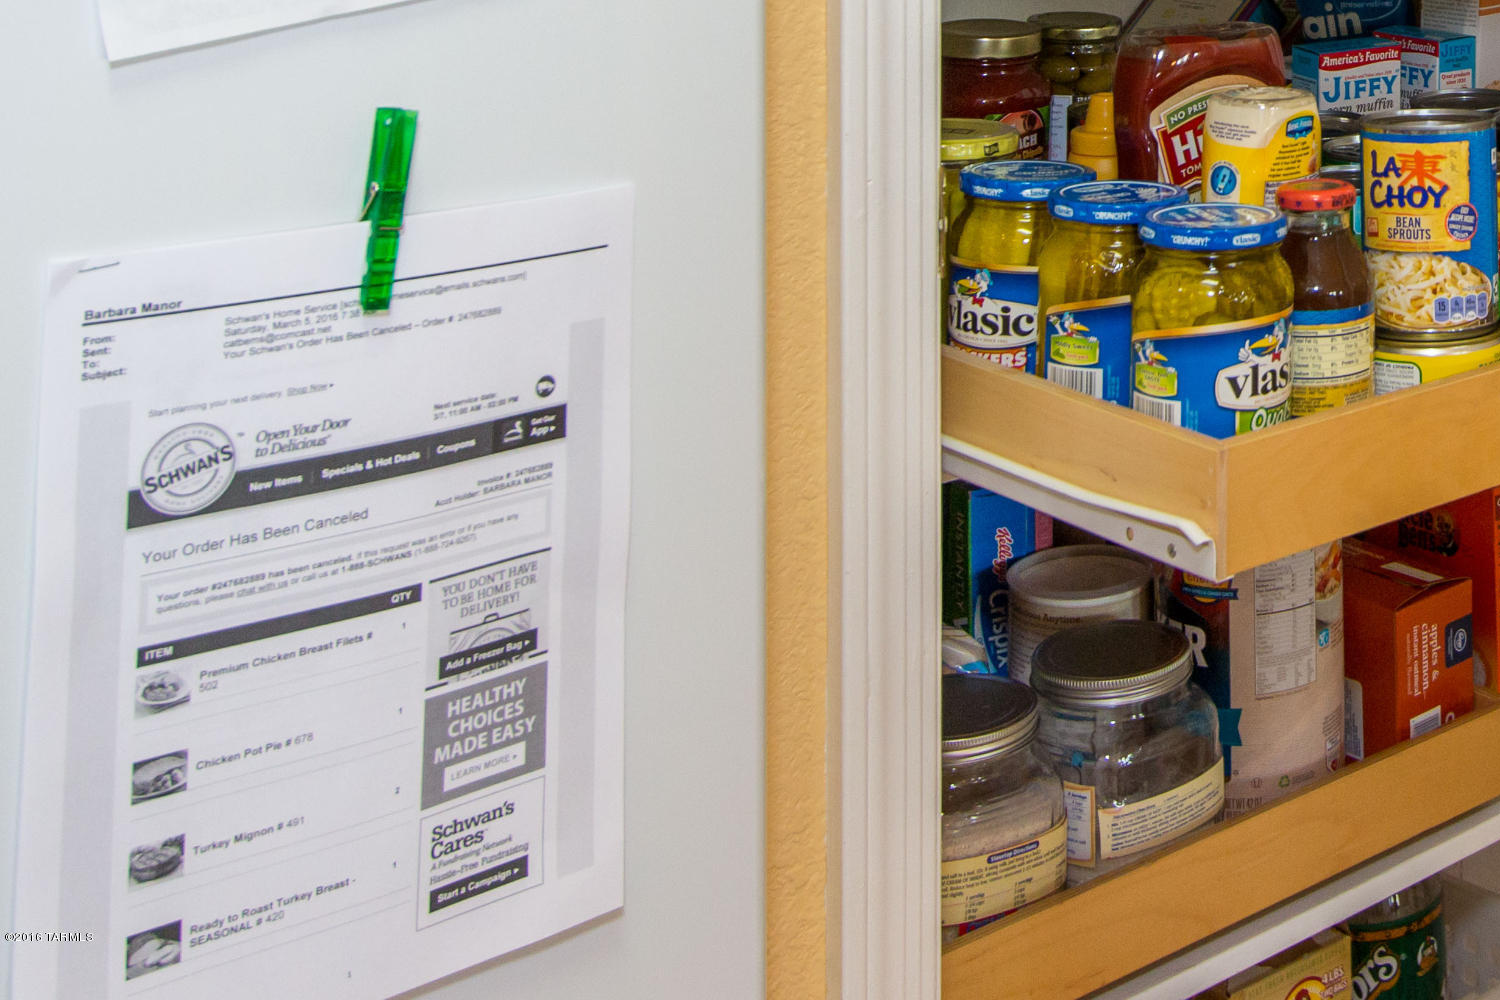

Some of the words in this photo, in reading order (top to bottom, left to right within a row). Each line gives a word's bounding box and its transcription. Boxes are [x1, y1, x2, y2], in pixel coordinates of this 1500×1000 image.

[1303, 2, 1363, 40] ain
[1321, 52, 1365, 68] America's
[1365, 50, 1400, 63] Favorite
[1407, 41, 1437, 55] Favorite
[1441, 43, 1473, 58] JIFFY
[1322, 75, 1398, 103] JIFFY
[1400, 65, 1434, 89] FFY
[1169, 111, 1184, 124] NO
[1356, 98, 1394, 113] muffin
[1181, 162, 1203, 178] TOM
[1371, 149, 1402, 178] LA
[1370, 179, 1450, 209] CHOY
[1387, 228, 1432, 240] SPROUTS
[1395, 216, 1421, 228] BEAN
[83, 306, 137, 321] Barbara
[141, 300, 182, 313] Manor
[82, 346, 112, 357] Sent:
[83, 335, 116, 346] From:
[81, 367, 127, 382] Subject:
[82, 360, 100, 369] To:
[1225, 362, 1291, 400] vlas
[255, 429, 290, 444] Open
[291, 423, 319, 438] Your
[322, 417, 352, 432] Door
[255, 447, 267, 458] to
[270, 438, 323, 455] Delicious
[437, 439, 476, 454] Coupons
[144, 444, 234, 494] SCHWAN'S
[322, 463, 364, 479] Specials
[376, 455, 393, 467] Hot
[395, 451, 421, 463] Deals
[249, 481, 273, 492] New
[142, 547, 177, 564] Your
[182, 538, 224, 556] Order
[230, 531, 258, 546] Has
[263, 522, 300, 540] Been
[304, 509, 369, 531] Canceled
[442, 583, 465, 597] YOU
[469, 569, 506, 590] DON'T
[508, 560, 538, 578] HAVE
[442, 597, 458, 610] TO
[460, 592, 474, 605] BE
[477, 581, 511, 600] HOME
[514, 574, 536, 589] FOR
[391, 590, 412, 603] QTY
[460, 592, 520, 618] DELIVERY!
[144, 646, 174, 661] ITEM
[199, 661, 249, 680] Premium
[252, 650, 296, 667] Chicken
[299, 641, 332, 657] Breast
[336, 634, 364, 648] Filets
[446, 658, 465, 670] Add
[472, 647, 504, 662] Freezer
[505, 640, 522, 652] Bag
[1421, 623, 1430, 690] cinnamon
[1429, 624, 1442, 666] apples
[1413, 660, 1422, 697] oatmeal
[1432, 670, 1440, 681] &
[448, 678, 527, 718] HEALTHY
[448, 699, 524, 738] CHOICES
[434, 732, 488, 764] MADE
[492, 715, 536, 745] EASY
[195, 752, 241, 770] Chicken
[244, 746, 262, 758] Pot
[265, 742, 282, 753] Pie
[450, 764, 482, 781] LEARN
[483, 754, 510, 769] MORE
[432, 800, 515, 842] Schwan's
[192, 839, 230, 855] Turkey
[234, 825, 274, 843] Mignon
[431, 830, 484, 860] Cares
[189, 917, 225, 934] Ready
[227, 913, 239, 923] to
[241, 902, 273, 917] Roast
[276, 891, 313, 908] Turkey
[315, 878, 349, 895] Breast
[189, 921, 253, 948] SEASONAL
